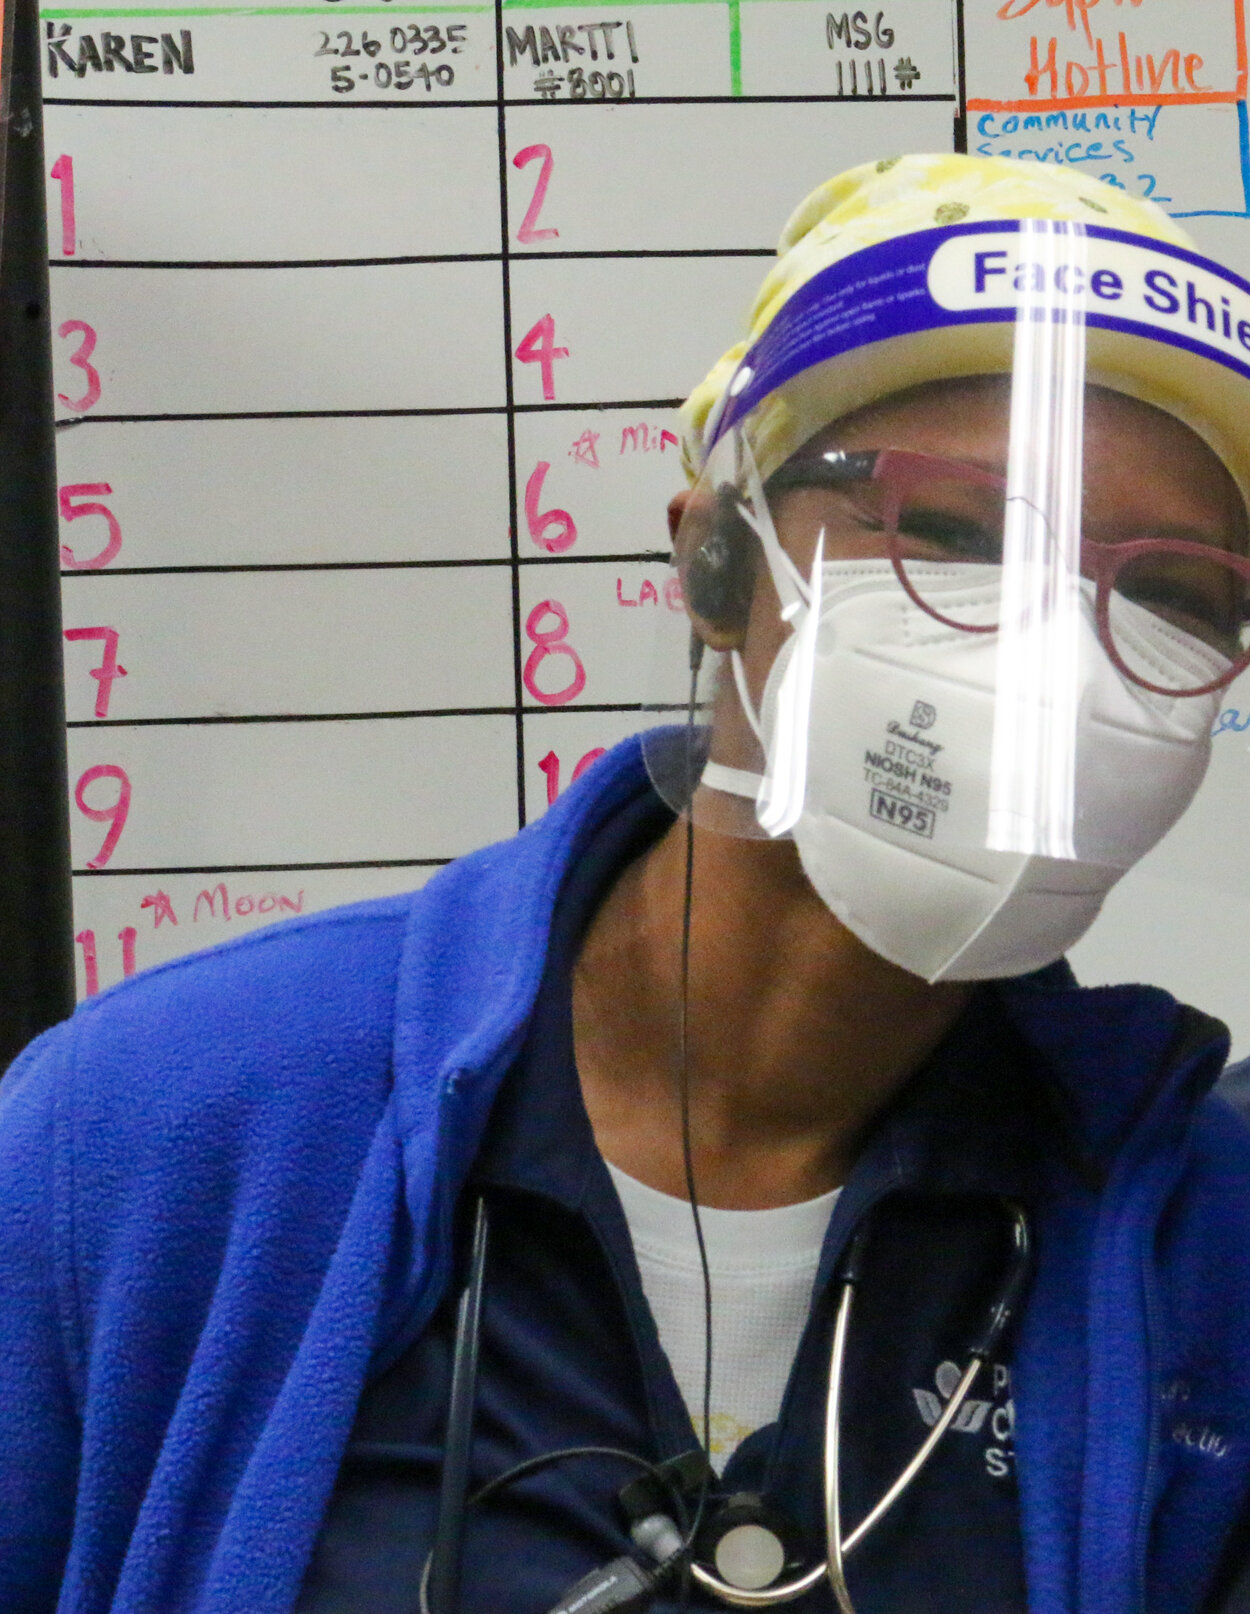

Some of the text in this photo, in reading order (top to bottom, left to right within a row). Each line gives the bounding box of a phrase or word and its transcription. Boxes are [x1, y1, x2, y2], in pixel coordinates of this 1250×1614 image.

[46, 23, 195, 78] KAREN
[505, 20, 639, 66] MARTTI
[826, 11, 895, 50] MSG
[533, 67, 636, 99] #8001
[51, 154, 75, 255] 1
[513, 143, 560, 245] 2
[972, 251, 1124, 301] Face
[57, 319, 101, 412] 3
[514, 313, 570, 400] 4
[58, 482, 122, 570] 5
[525, 461, 577, 553] 6
[63, 626, 128, 718] 7
[523, 599, 586, 706] 8
[864, 751, 952, 796] NIOSH N95
[885, 740, 935, 772] DTC3X
[75, 764, 132, 869] 9
[877, 796, 928, 831] N95
